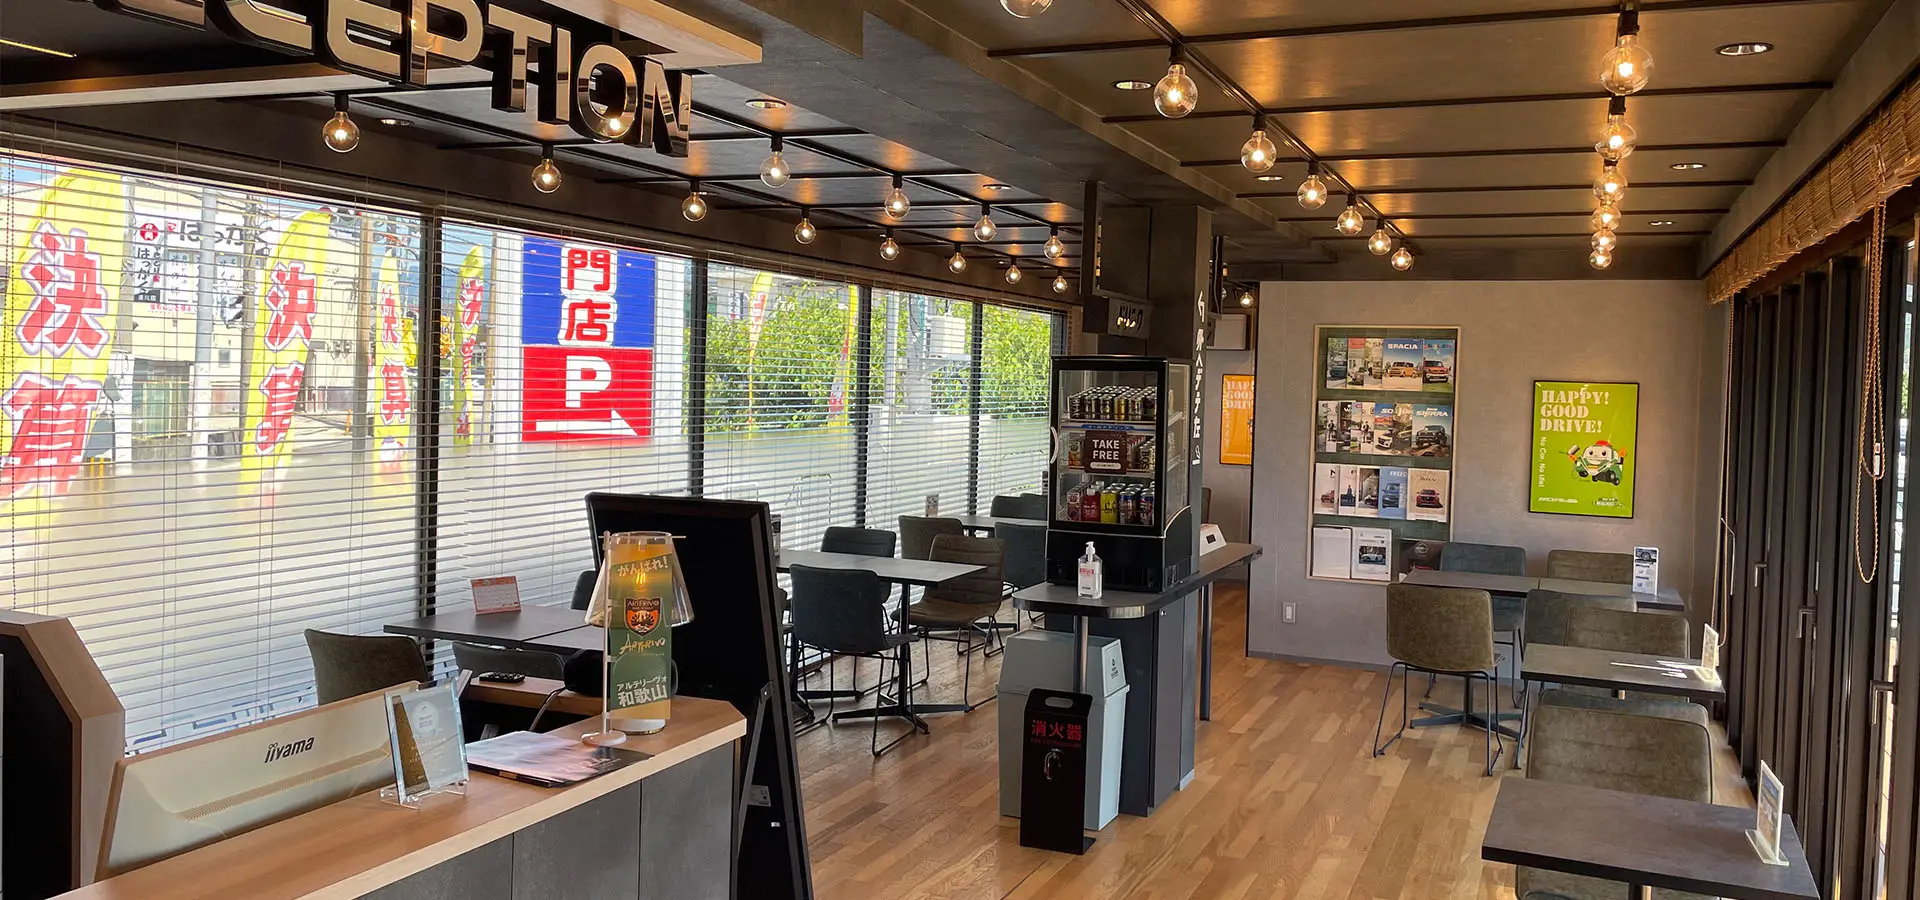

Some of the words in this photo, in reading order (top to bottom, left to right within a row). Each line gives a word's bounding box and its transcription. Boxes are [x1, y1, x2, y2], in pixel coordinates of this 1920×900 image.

[565, 355, 612, 408] P
[1541, 389, 1610, 405] HAPPY!
[1540, 403, 1589, 418] GOOD
[1539, 418, 1603, 433] DRIVE!
[1092, 439, 1120, 449] TAKE
[1092, 450, 1120, 460] FREE
[618, 683, 668, 707] 和歌山
[1031, 719, 1083, 741] 消火器
[263, 736, 315, 764] iiyama
